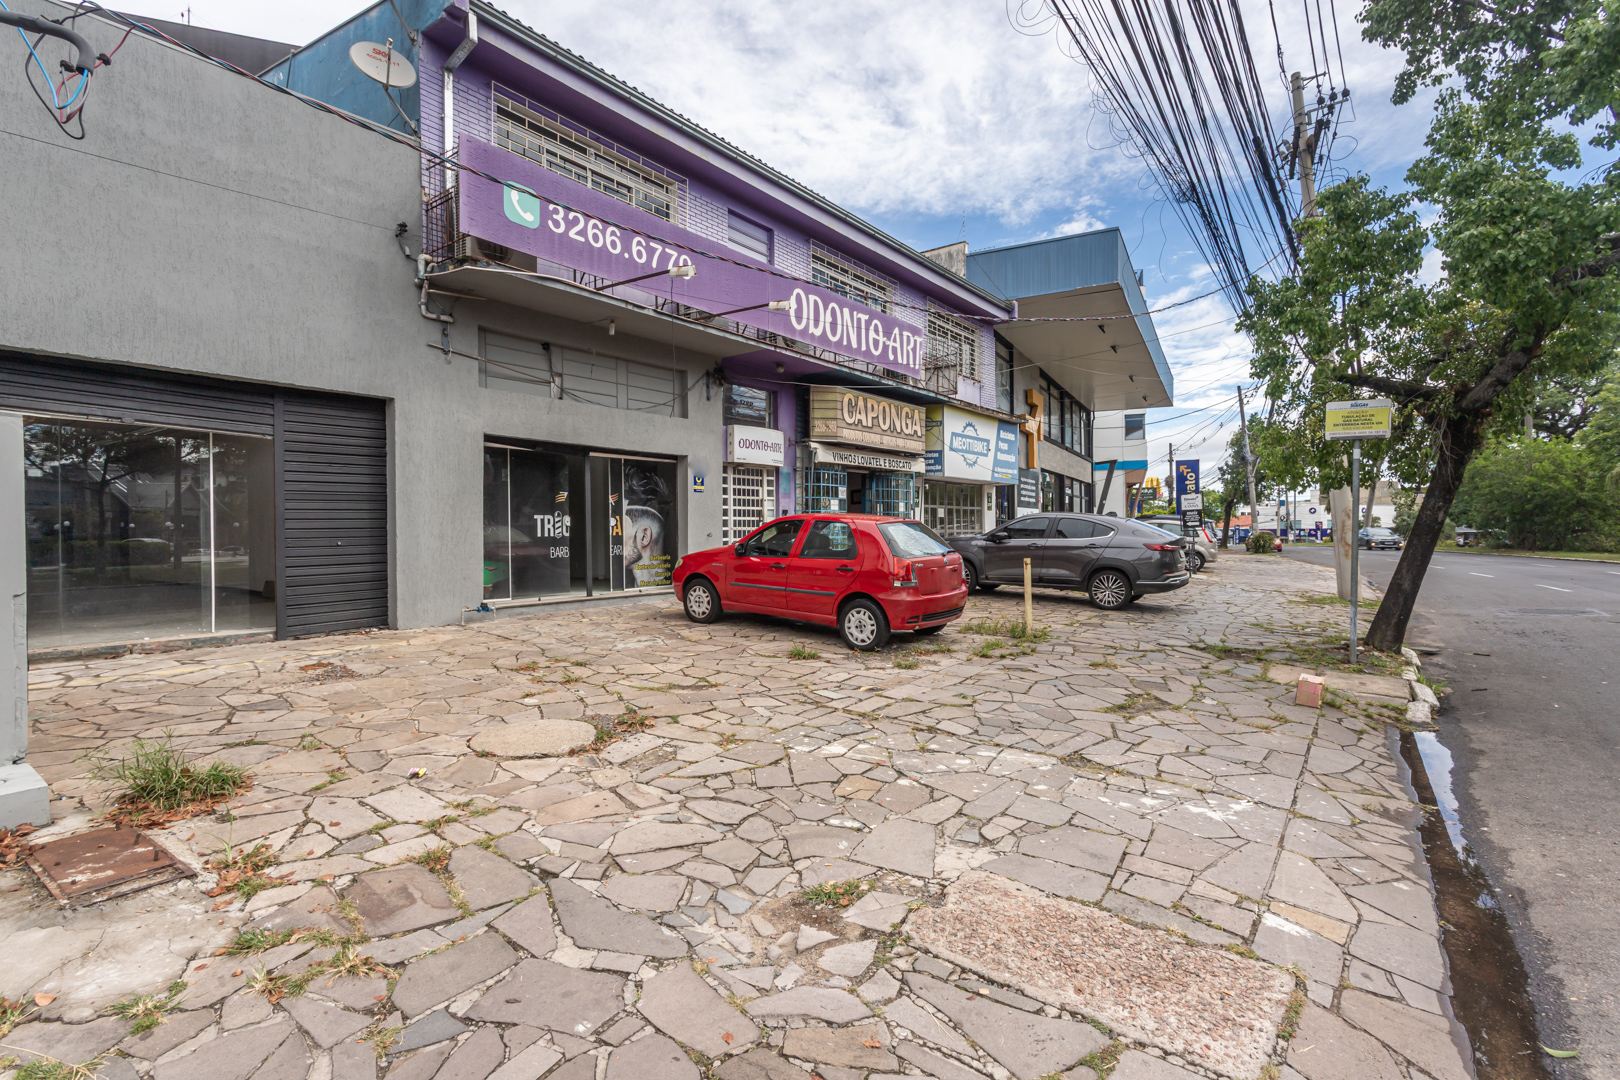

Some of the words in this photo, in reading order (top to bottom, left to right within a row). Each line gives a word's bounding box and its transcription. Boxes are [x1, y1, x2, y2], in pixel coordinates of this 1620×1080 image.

[789, 288, 923, 370] ODONTO-ART
[842, 393, 922, 437] CAPONGA
[832, 451, 856, 463] VINHOS
[857, 453, 882, 467] LOVATEL
[888, 459, 912, 470] BOSCATO
[952, 436, 987, 454] MEOTTIBIKE
